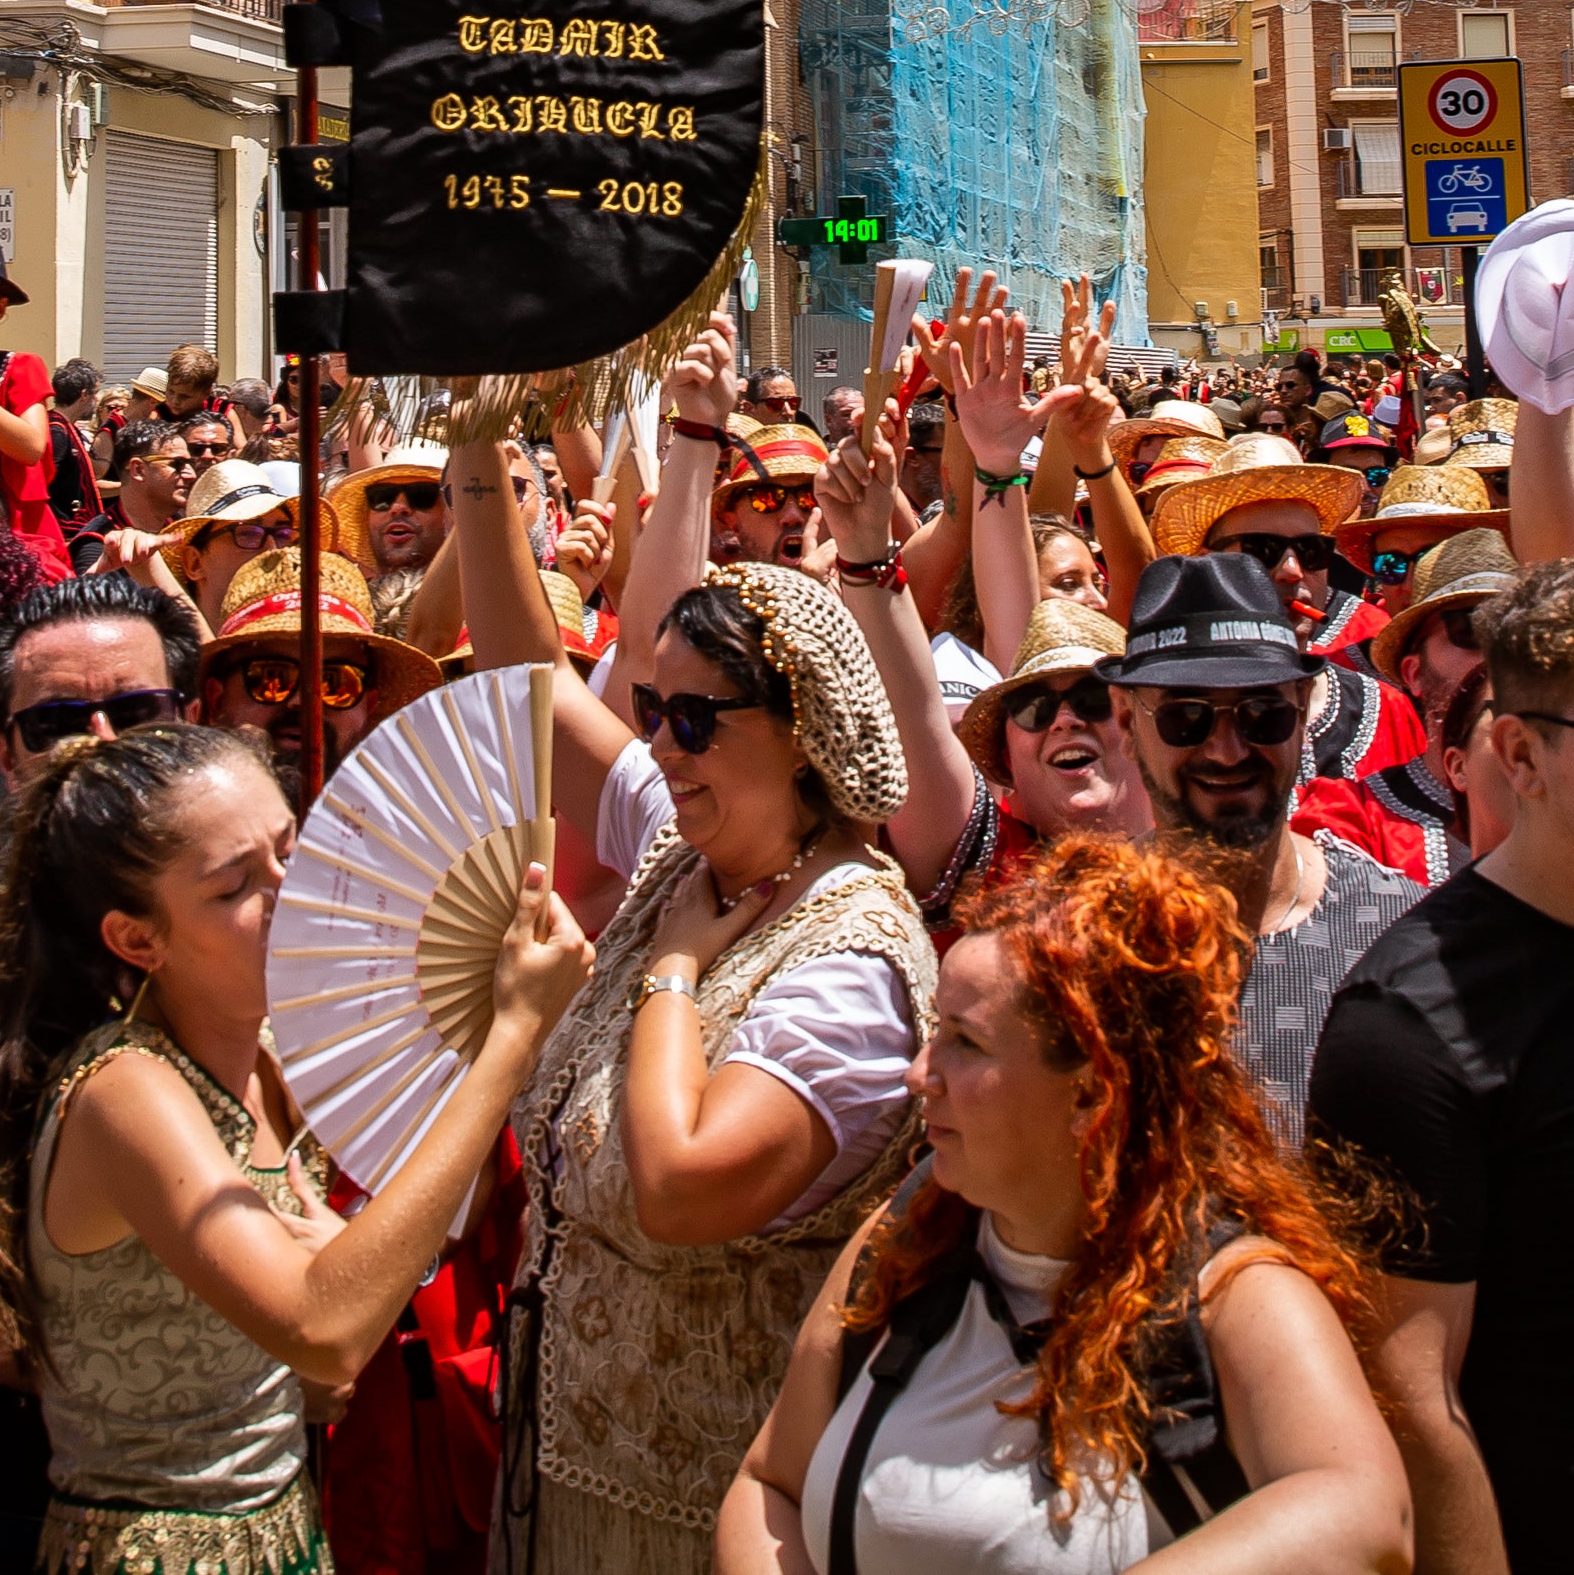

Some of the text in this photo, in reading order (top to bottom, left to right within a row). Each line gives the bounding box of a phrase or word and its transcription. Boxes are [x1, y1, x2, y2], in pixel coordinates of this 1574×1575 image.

[459, 15, 665, 60] TADMIR
[1440, 90, 1485, 116] 30
[431, 92, 698, 141] ORIHUELA
[1411, 139, 1517, 155] CICLOCALLE
[444, 173, 530, 210] 1975
[597, 177, 683, 216] 2018
[825, 219, 878, 242] 14:01
[1329, 335, 1356, 347] CRC
[1158, 626, 1187, 648] 2022
[1210, 621, 1262, 641] ANTONIA
